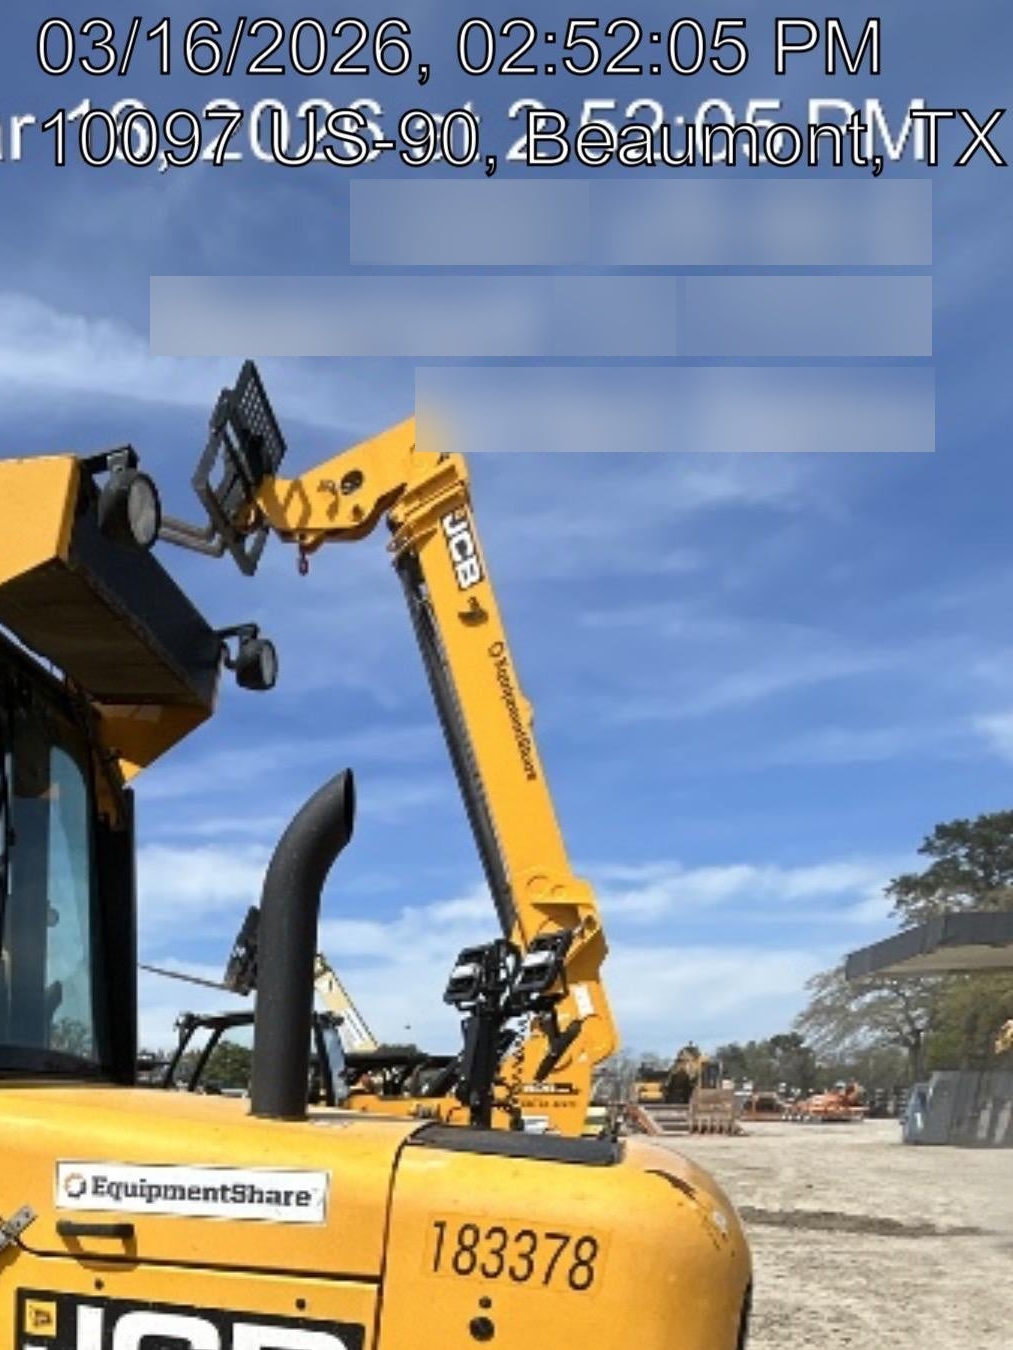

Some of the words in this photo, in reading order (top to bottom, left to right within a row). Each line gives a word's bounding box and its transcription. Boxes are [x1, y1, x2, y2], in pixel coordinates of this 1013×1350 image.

[442, 511, 483, 590] JCB
[91, 1175, 313, 1208] EquipmentShare
[433, 1220, 599, 1292] 183378
